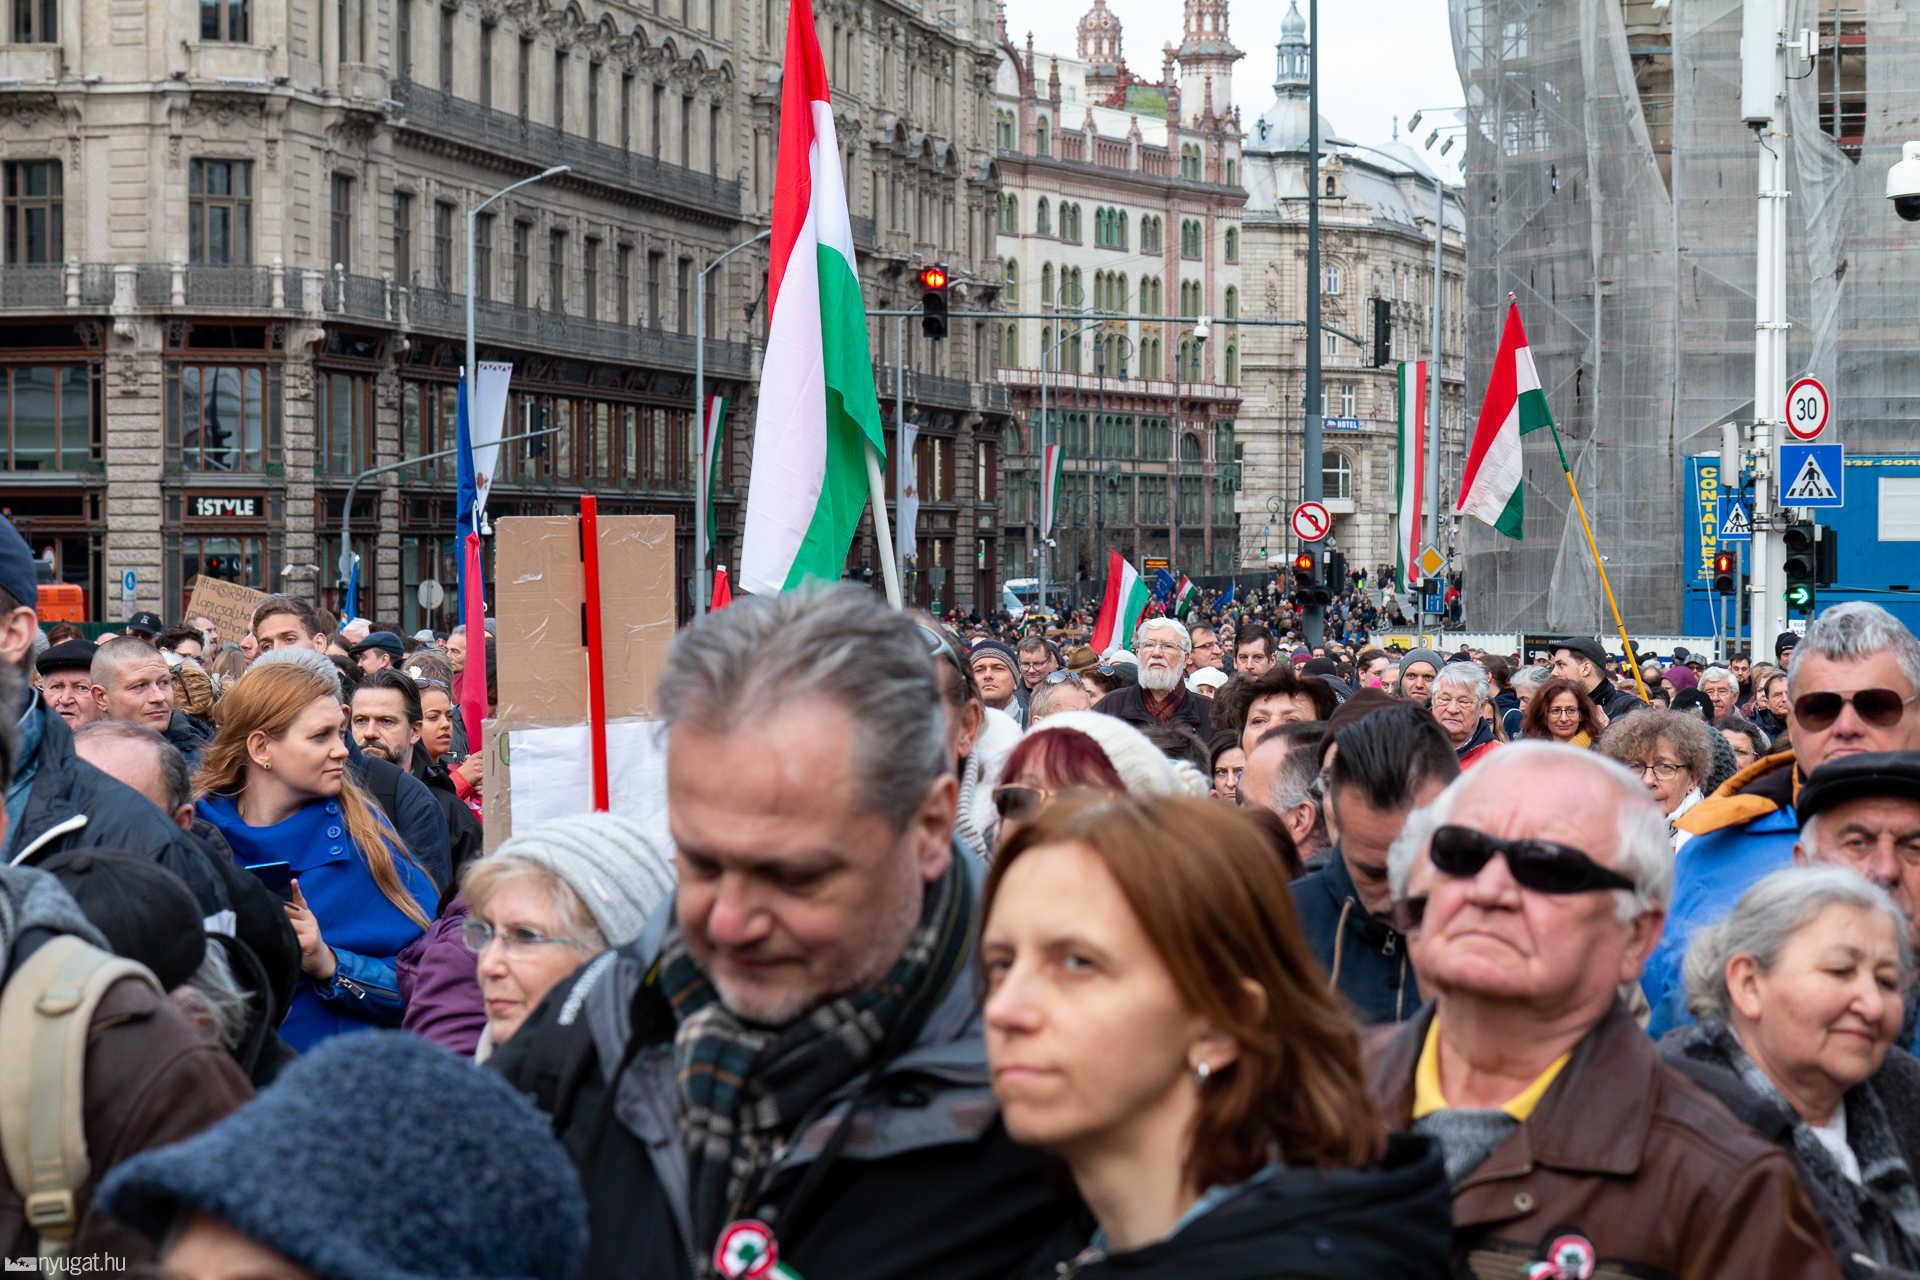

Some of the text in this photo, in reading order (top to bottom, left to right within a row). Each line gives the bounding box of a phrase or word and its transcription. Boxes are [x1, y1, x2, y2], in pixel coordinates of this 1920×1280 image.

[1796, 397, 1817, 421] 30
[196, 497, 254, 516] iSTYLE
[1701, 467, 1717, 568] CONTAINEX
